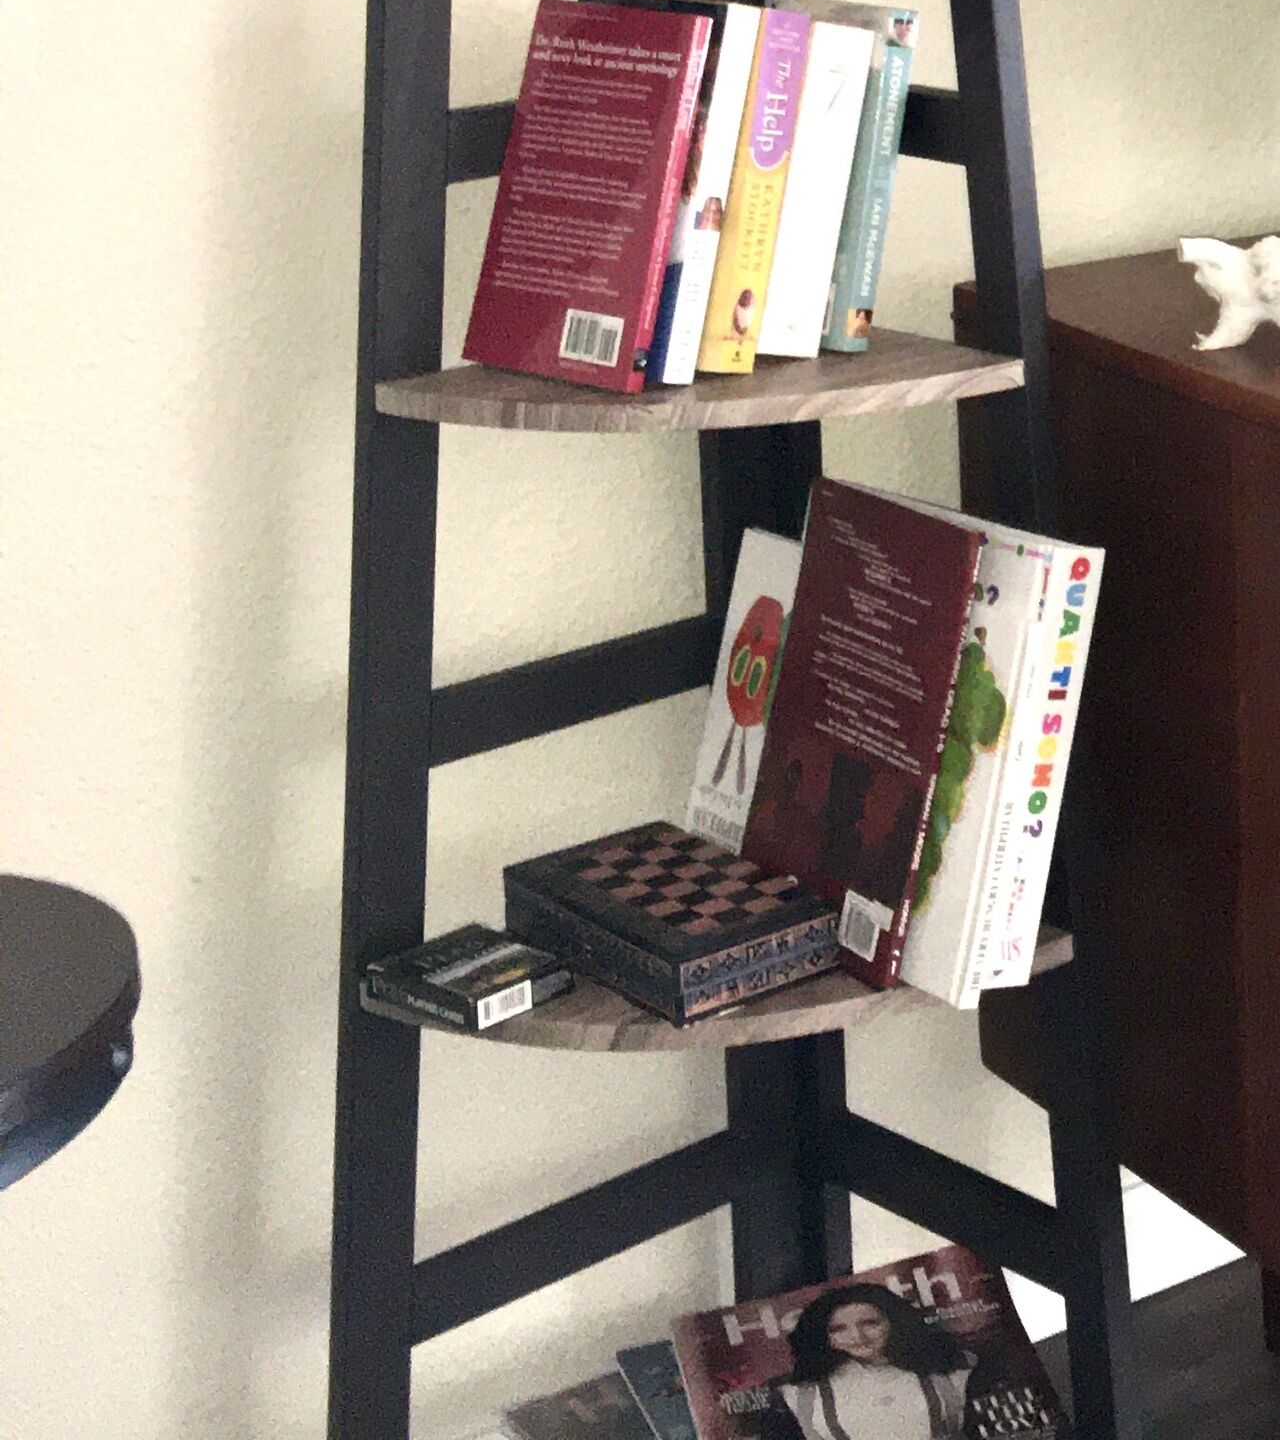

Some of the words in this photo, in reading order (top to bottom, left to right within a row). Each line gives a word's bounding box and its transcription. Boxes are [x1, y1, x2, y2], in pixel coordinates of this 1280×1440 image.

[776, 59, 792, 89] The
[880, 55, 905, 157] ATONEMENT
[755, 91, 789, 152] Help
[752, 184, 774, 274] KATHRYN
[871, 198, 883, 226] IAN
[1048, 556, 1091, 702] QUANTI
[722, 1266, 962, 1347] Hth
